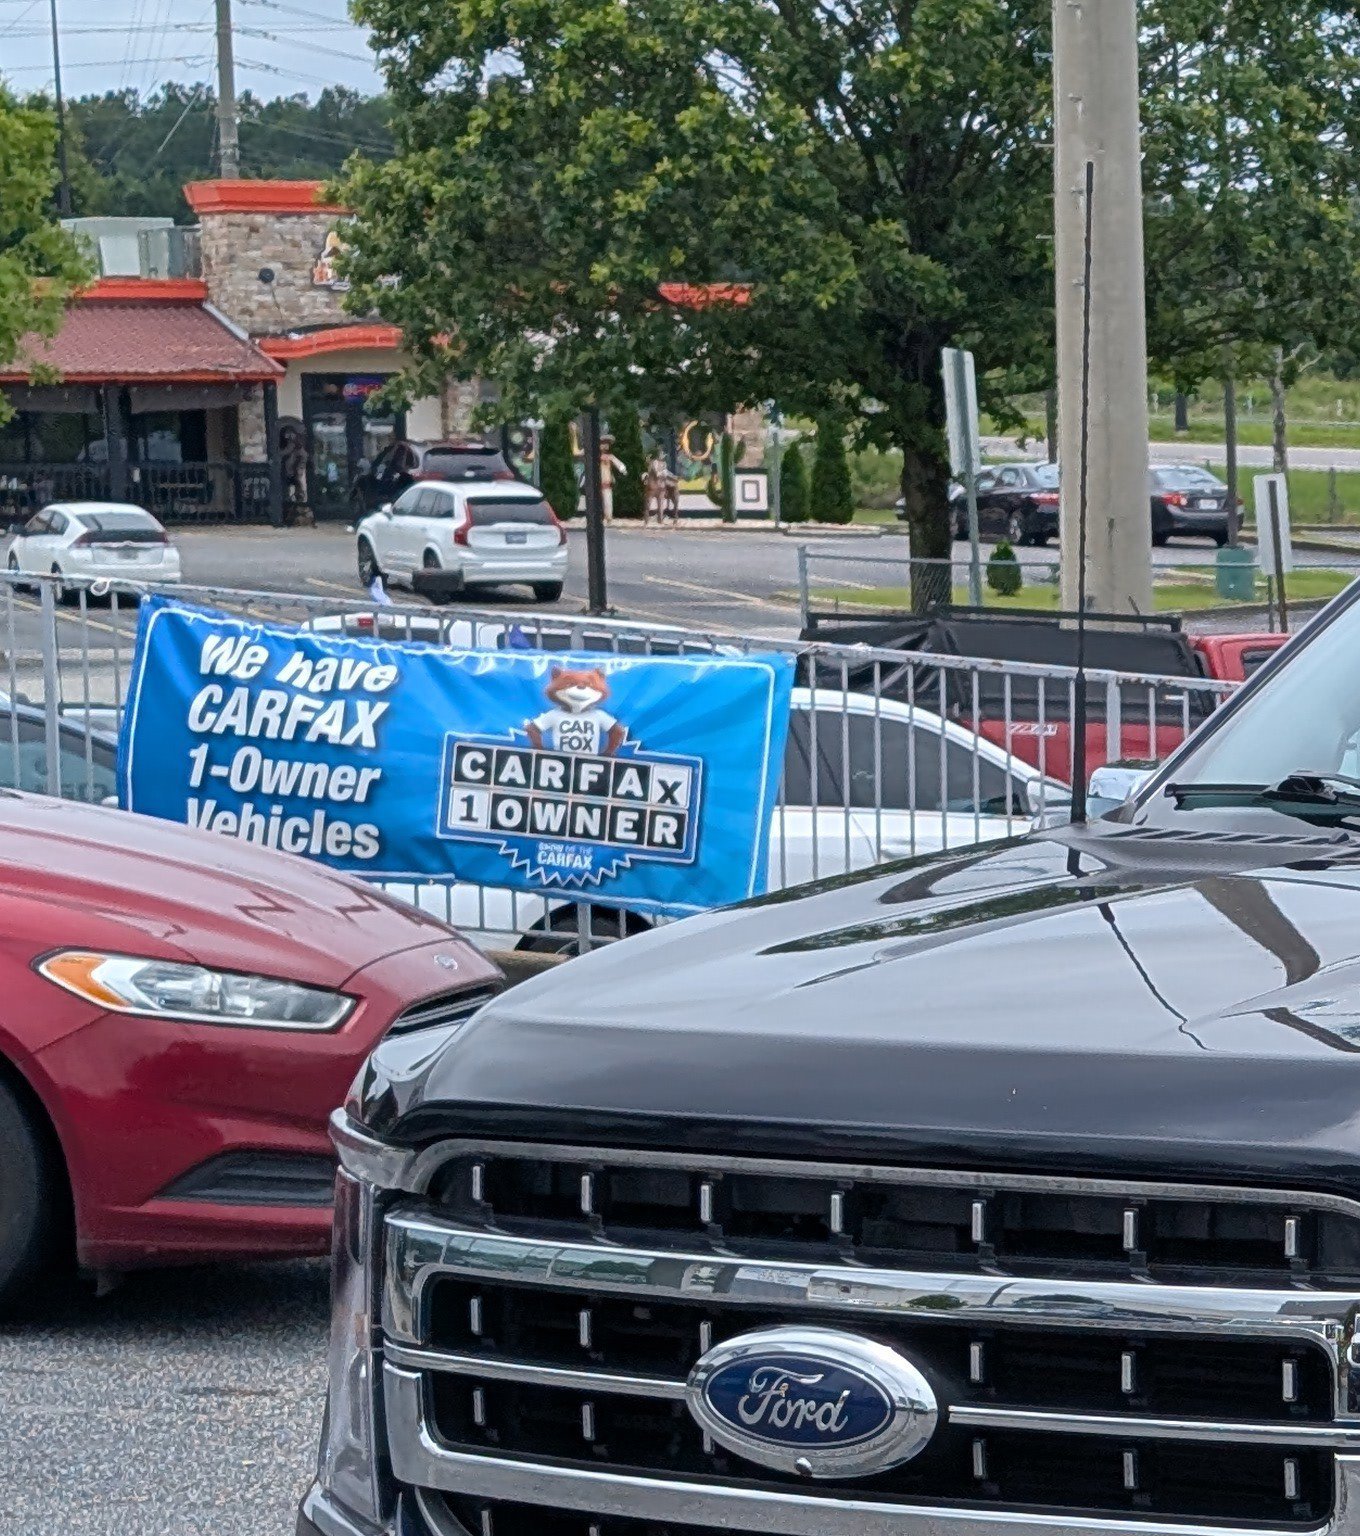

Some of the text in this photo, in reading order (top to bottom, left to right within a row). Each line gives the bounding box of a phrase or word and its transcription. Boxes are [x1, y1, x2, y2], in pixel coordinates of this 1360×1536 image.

[200, 634, 398, 693] We have
[188, 684, 390, 748] CARFAX
[559, 720, 594, 735] CAR
[559, 735, 593, 752] FOX
[189, 743, 382, 802] 1-Owner
[461, 751, 684, 805] CARFAX
[187, 797, 380, 859] Vehicles
[460, 794, 679, 845] 1 OWNER
[537, 851, 593, 870] CARFAX
[738, 1366, 850, 1433] Ford
